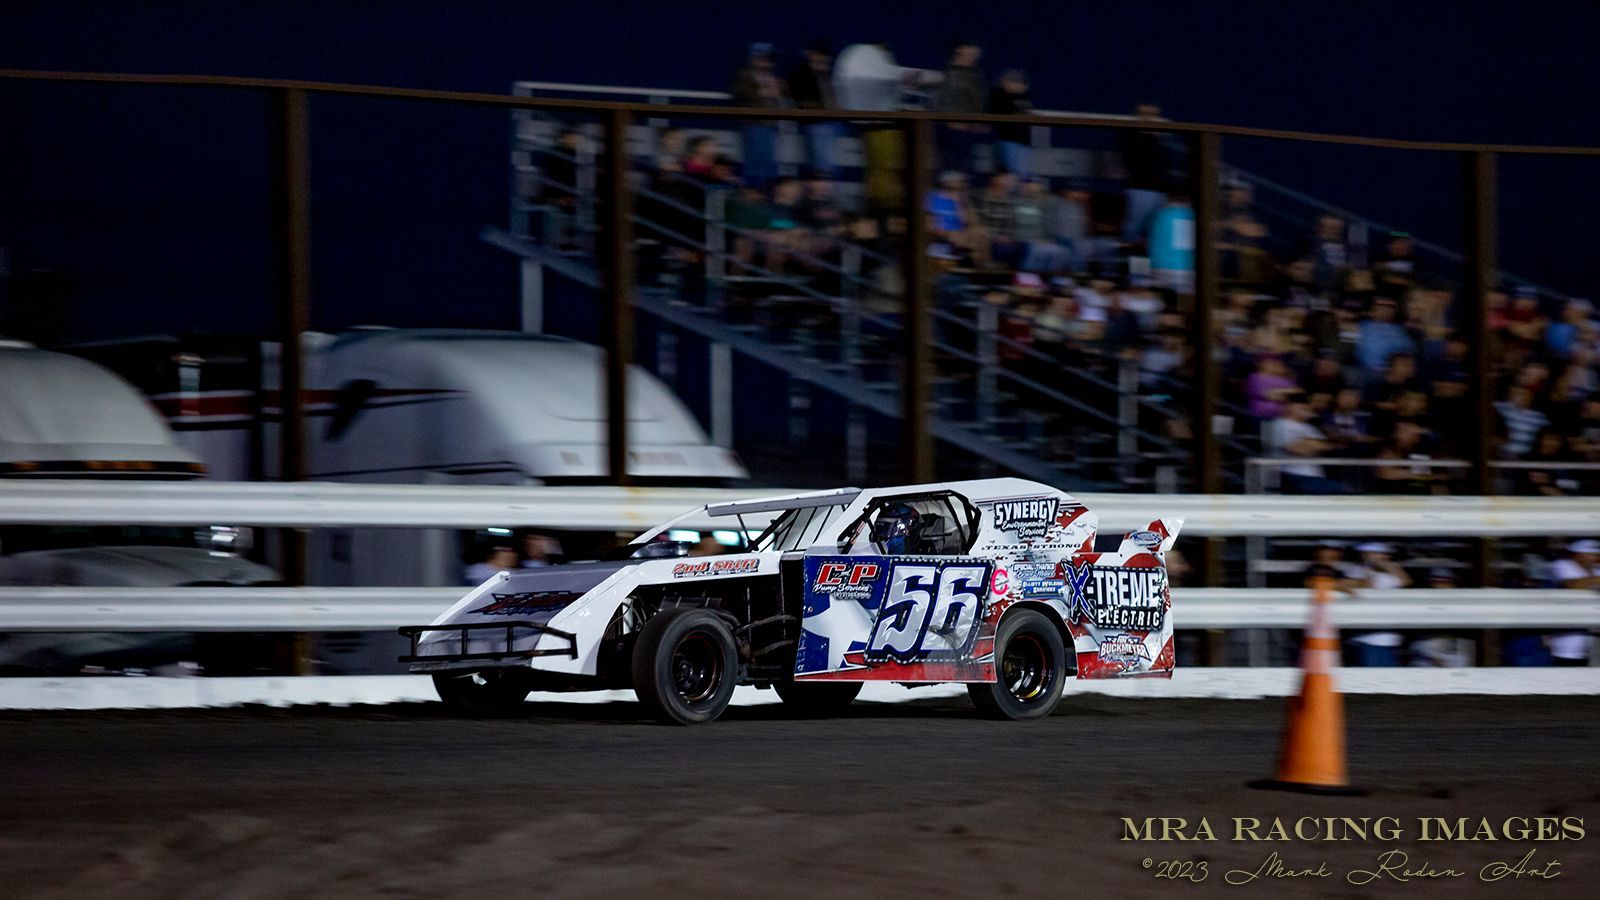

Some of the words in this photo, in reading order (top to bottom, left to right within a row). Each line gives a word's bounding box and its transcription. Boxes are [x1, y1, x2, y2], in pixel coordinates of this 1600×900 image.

[995, 499, 1057, 526] SYNERGY
[1002, 519, 1047, 530] Environmental
[1018, 527, 1046, 537] Services
[672, 561, 710, 573] 2nd
[713, 559, 759, 571] Shift
[1013, 563, 1034, 571] SPECIAL
[1036, 563, 1055, 571] THANKS
[812, 584, 837, 593] Pump
[1063, 562, 1160, 619] X-TREME
[869, 565, 987, 653] 56
[1097, 609, 1160, 627] ELECTRIC
[1100, 642, 1150, 659] BUCKMEYER
